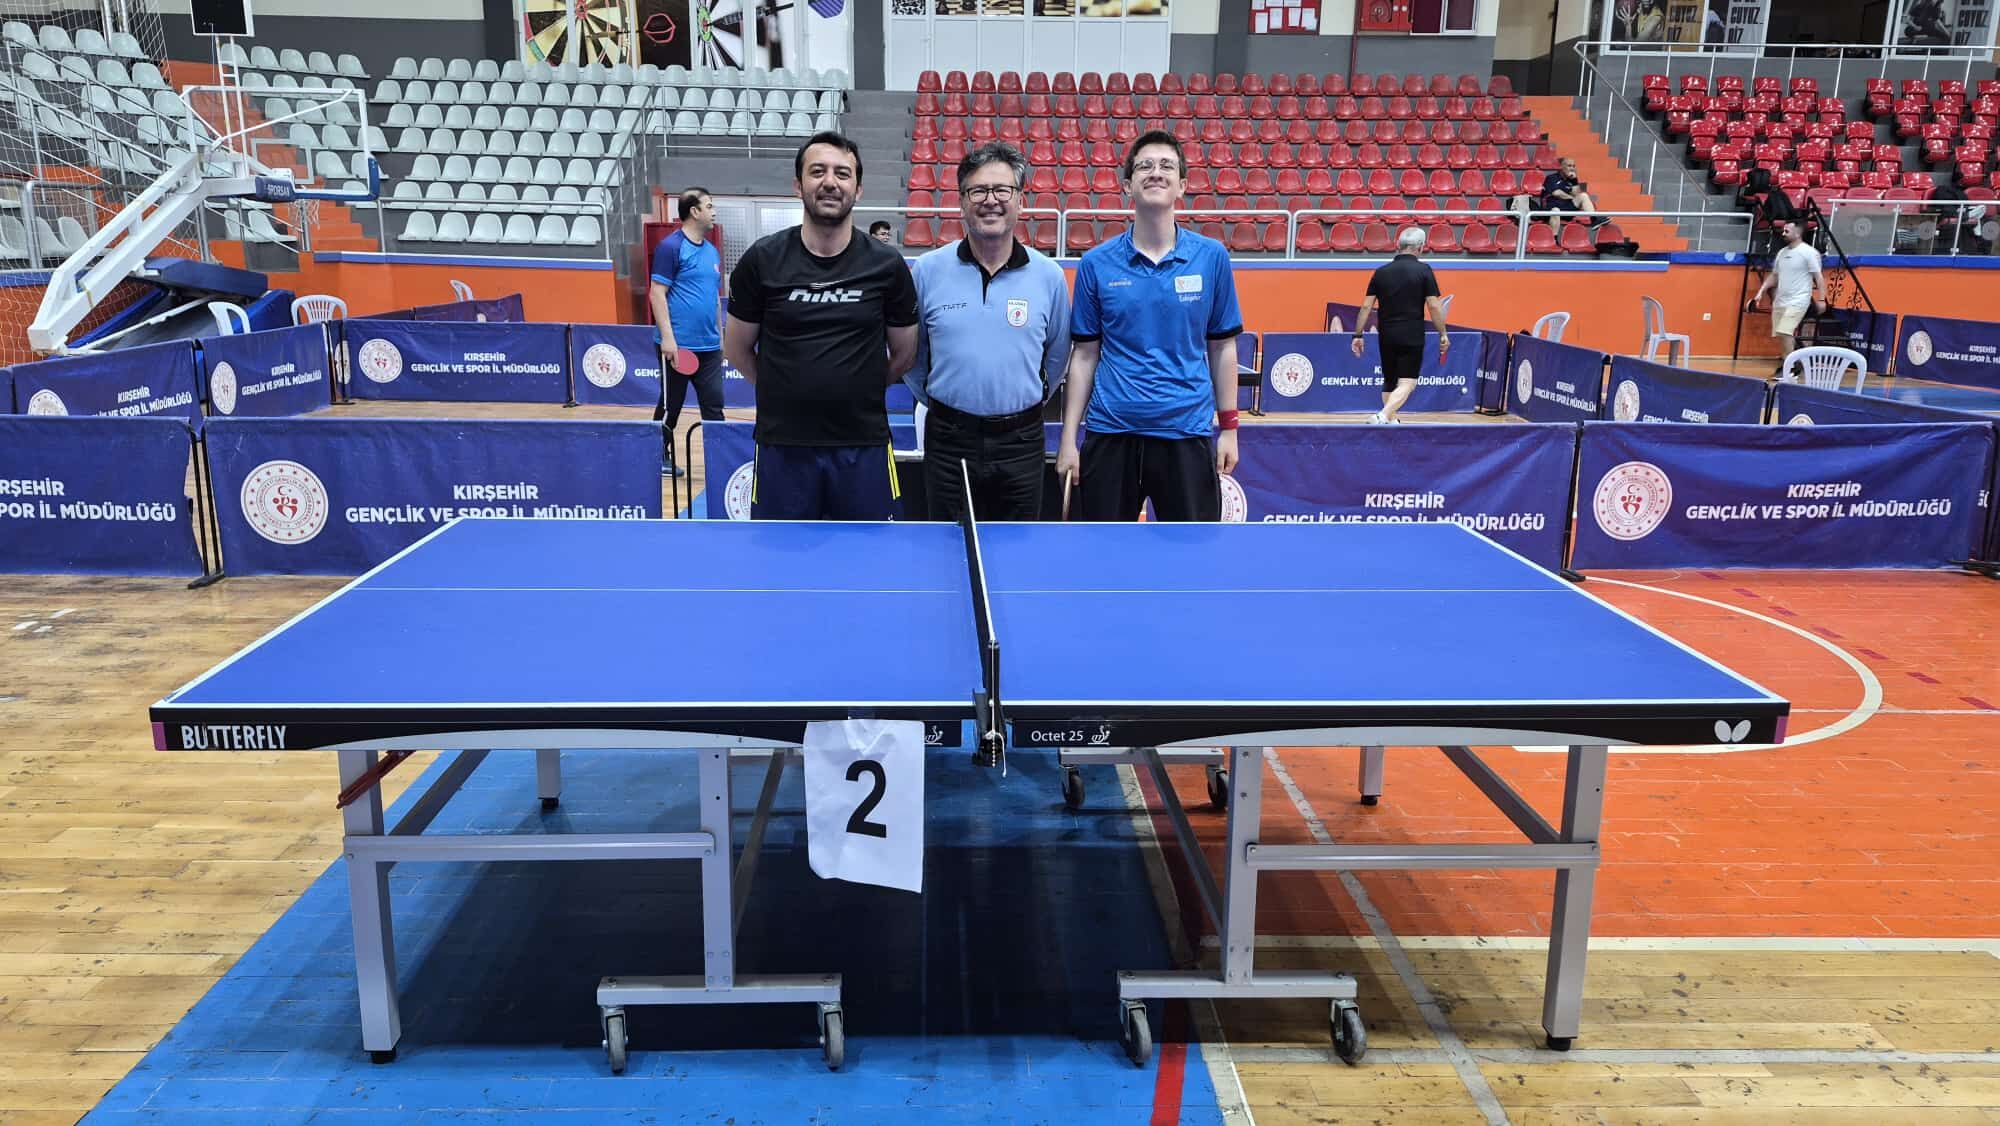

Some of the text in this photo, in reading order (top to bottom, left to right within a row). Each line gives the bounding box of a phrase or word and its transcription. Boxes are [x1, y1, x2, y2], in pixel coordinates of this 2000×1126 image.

[463, 352, 506, 363] KIRŞEHİR
[411, 362, 560, 375] GENÇLİK VE SPOR İL MÜDÜRLÜĞÜ
[634, 368, 660, 378] GENÇ
[1321, 376, 1358, 388] GENÇLİK
[1361, 377, 1375, 386] VE
[1417, 375, 1466, 386] ÜDÜRLÜĞÜ
[117, 385, 151, 404] KIRŞEHİR
[119, 404, 140, 417] SPOR
[140, 401, 150, 414] İL
[0, 477, 65, 497] RŞEHİR
[453, 481, 539, 502] KIRŞEHİR
[1787, 481, 1862, 500] KIRŞEHİR
[1364, 491, 1445, 511] KIRŞEHİR
[1686, 498, 1951, 522] GENÇLİK VE SPOR İL MÜDÜRLÜĞÜ
[0, 500, 177, 522] POR İL MÜDÜRLÜĞÜ
[345, 504, 426, 525] GENÇLİK
[429, 507, 454, 522] VE
[458, 507, 508, 518] SPOR
[533, 504, 646, 520] MÜDÜRLÜĞÜ
[181, 725, 287, 749] BUTTERFLY
[1031, 730, 1065, 742] Octet
[1069, 730, 1084, 742] 25
[845, 759, 887, 839] 2
